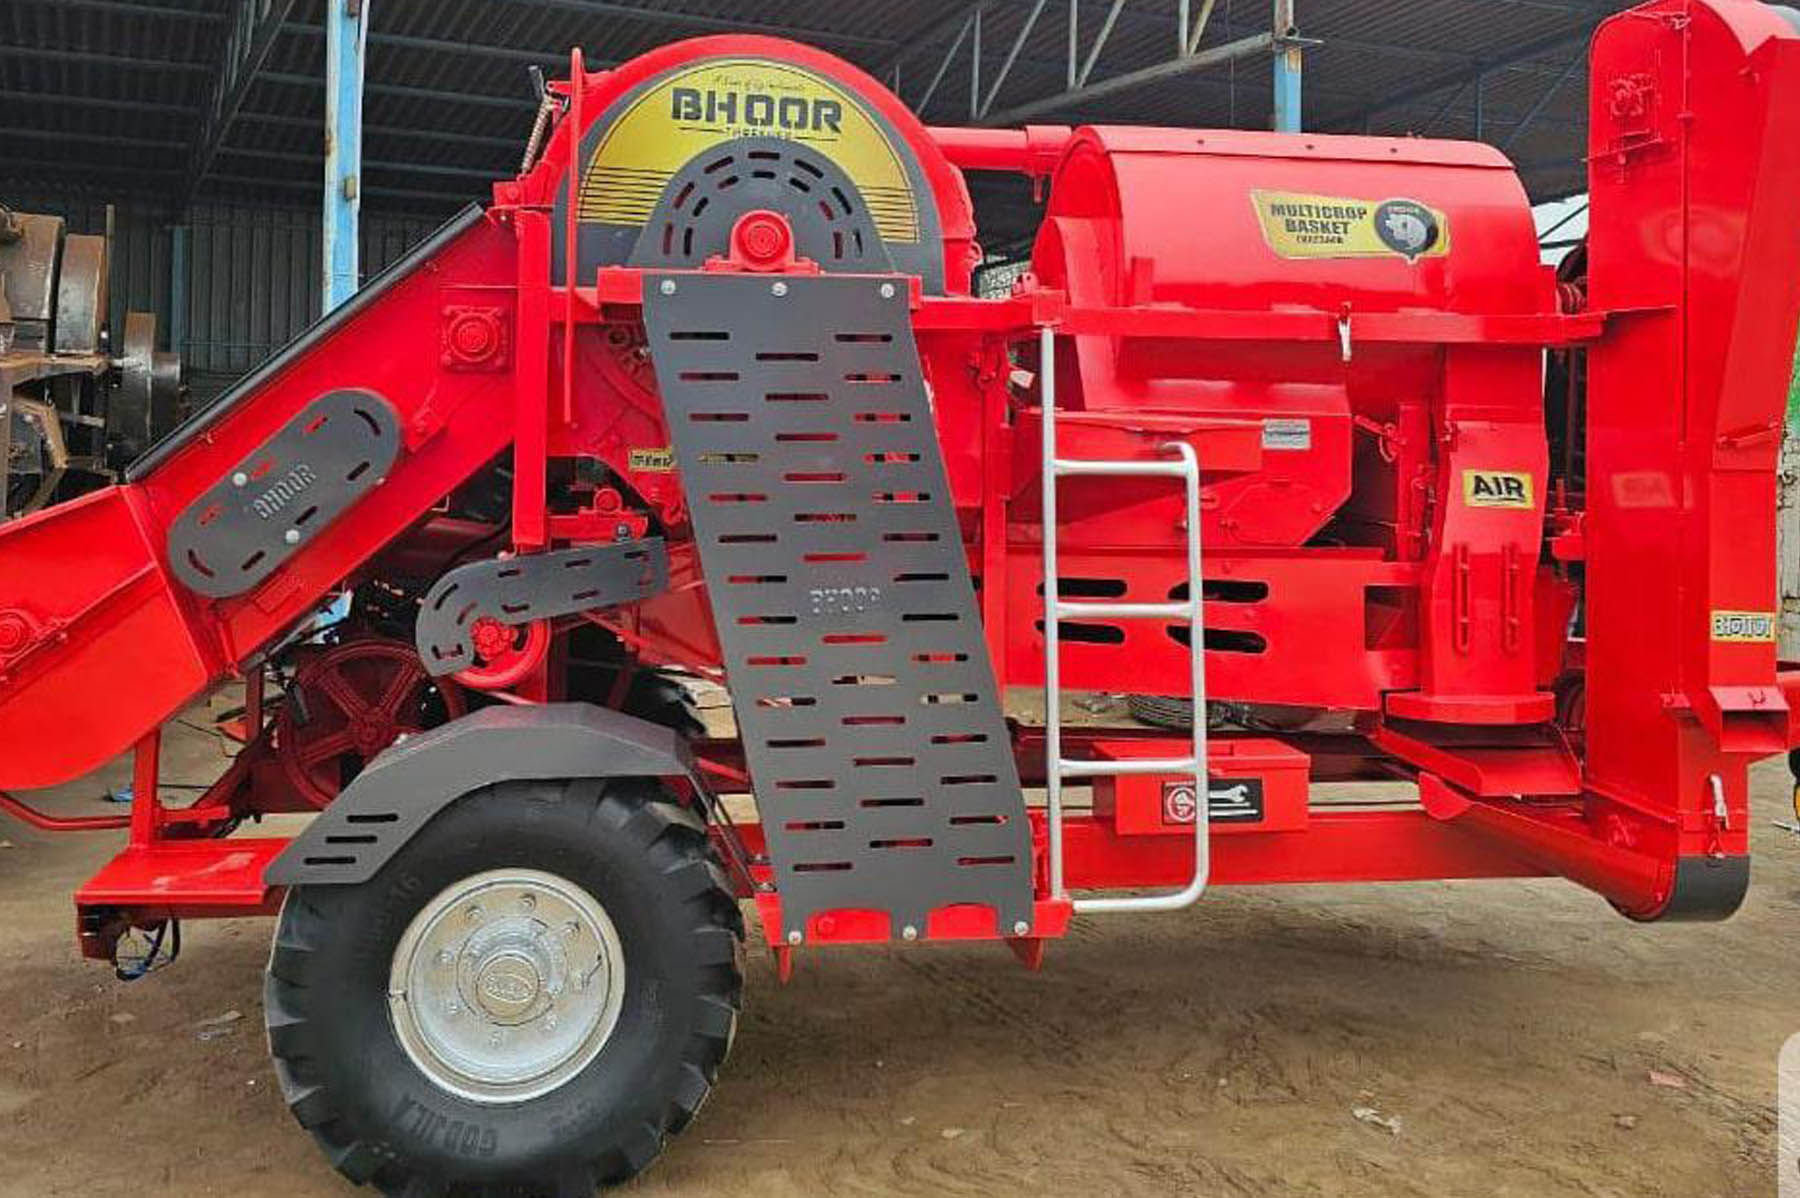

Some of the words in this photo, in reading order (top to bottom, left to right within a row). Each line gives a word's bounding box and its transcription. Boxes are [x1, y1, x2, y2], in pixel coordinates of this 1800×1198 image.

[672, 87, 842, 134] BHOOR
[1270, 203, 1368, 220] MULTICROP
[1285, 218, 1351, 234] BASKET
[1473, 475, 1526, 499] AIR
